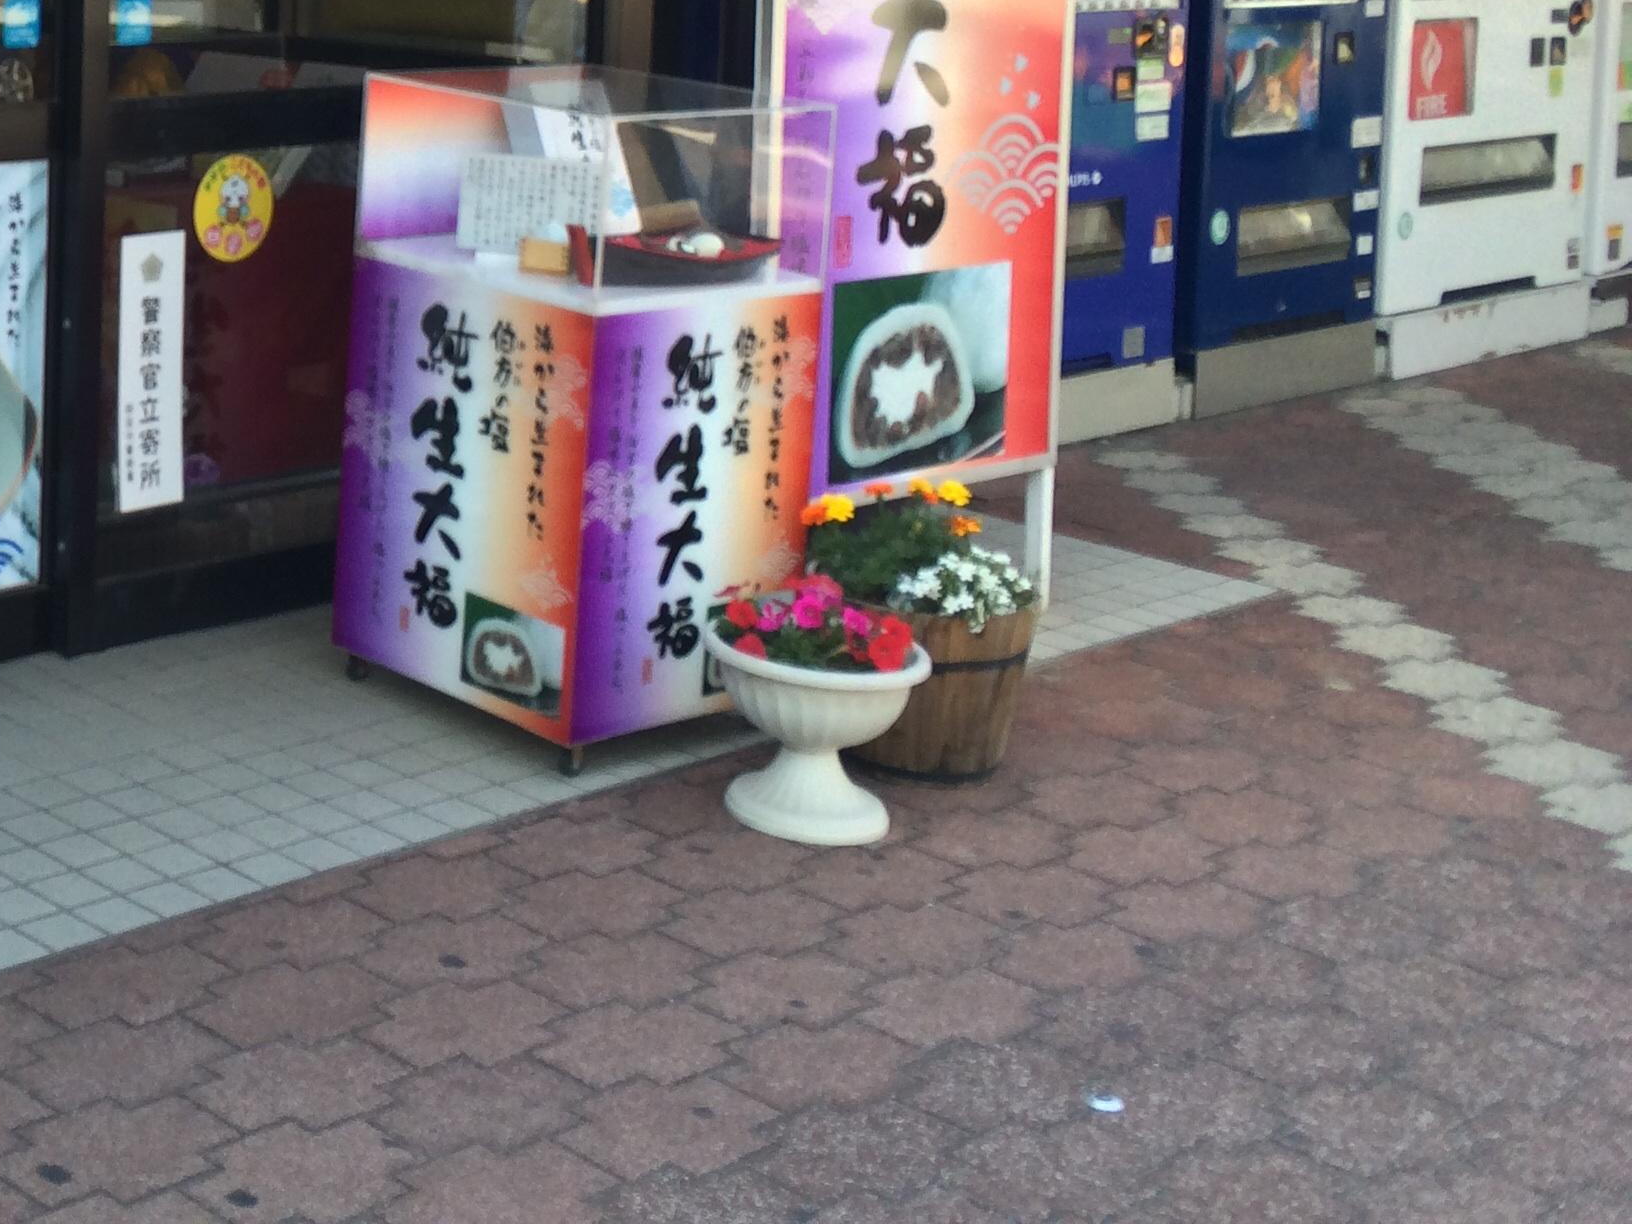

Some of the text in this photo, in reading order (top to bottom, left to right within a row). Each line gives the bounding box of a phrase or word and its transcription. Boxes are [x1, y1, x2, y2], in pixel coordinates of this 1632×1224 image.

[403, 304, 479, 629] 純生大福
[647, 333, 722, 660] 純生大福
